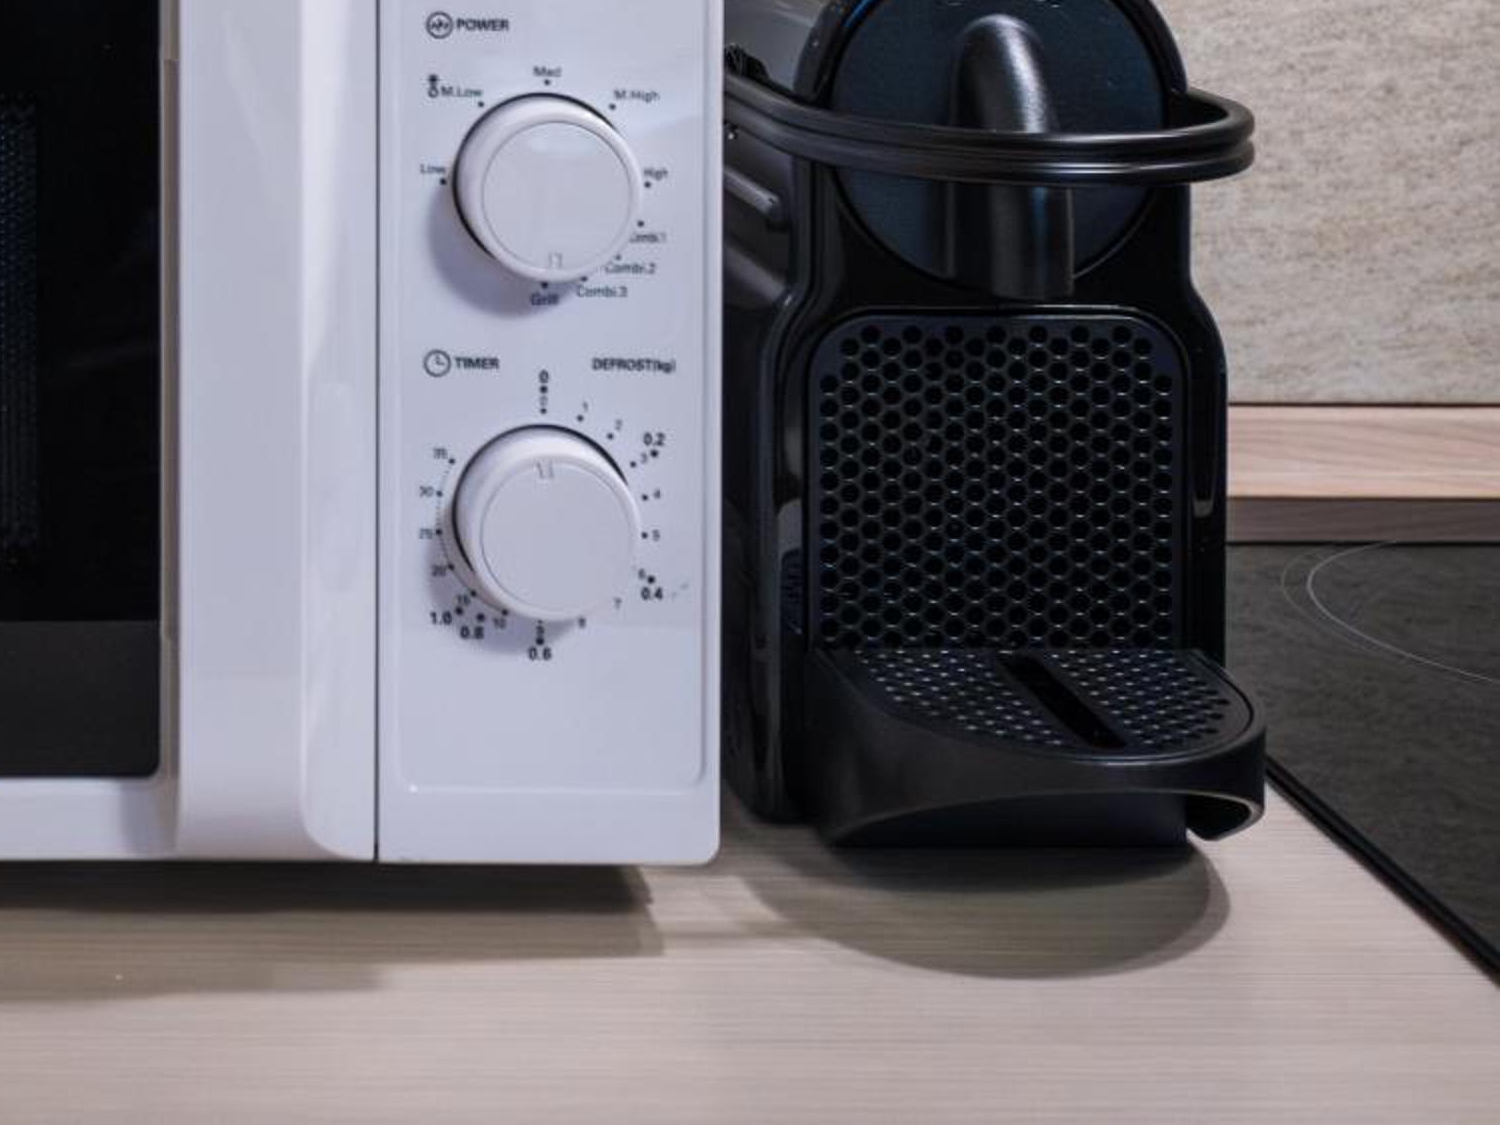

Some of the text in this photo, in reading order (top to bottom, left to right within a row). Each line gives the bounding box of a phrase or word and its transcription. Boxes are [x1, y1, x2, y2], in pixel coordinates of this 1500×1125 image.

[456, 18, 509, 31] POWER
[454, 357, 499, 369] TIMER
[592, 358, 676, 374] DEFROST(kg)
[643, 432, 666, 446] 0.2
[641, 586, 664, 601] 0.4
[429, 611, 453, 625] 1.0
[460, 626, 485, 640] 0.8
[528, 646, 552, 661] 0.6
